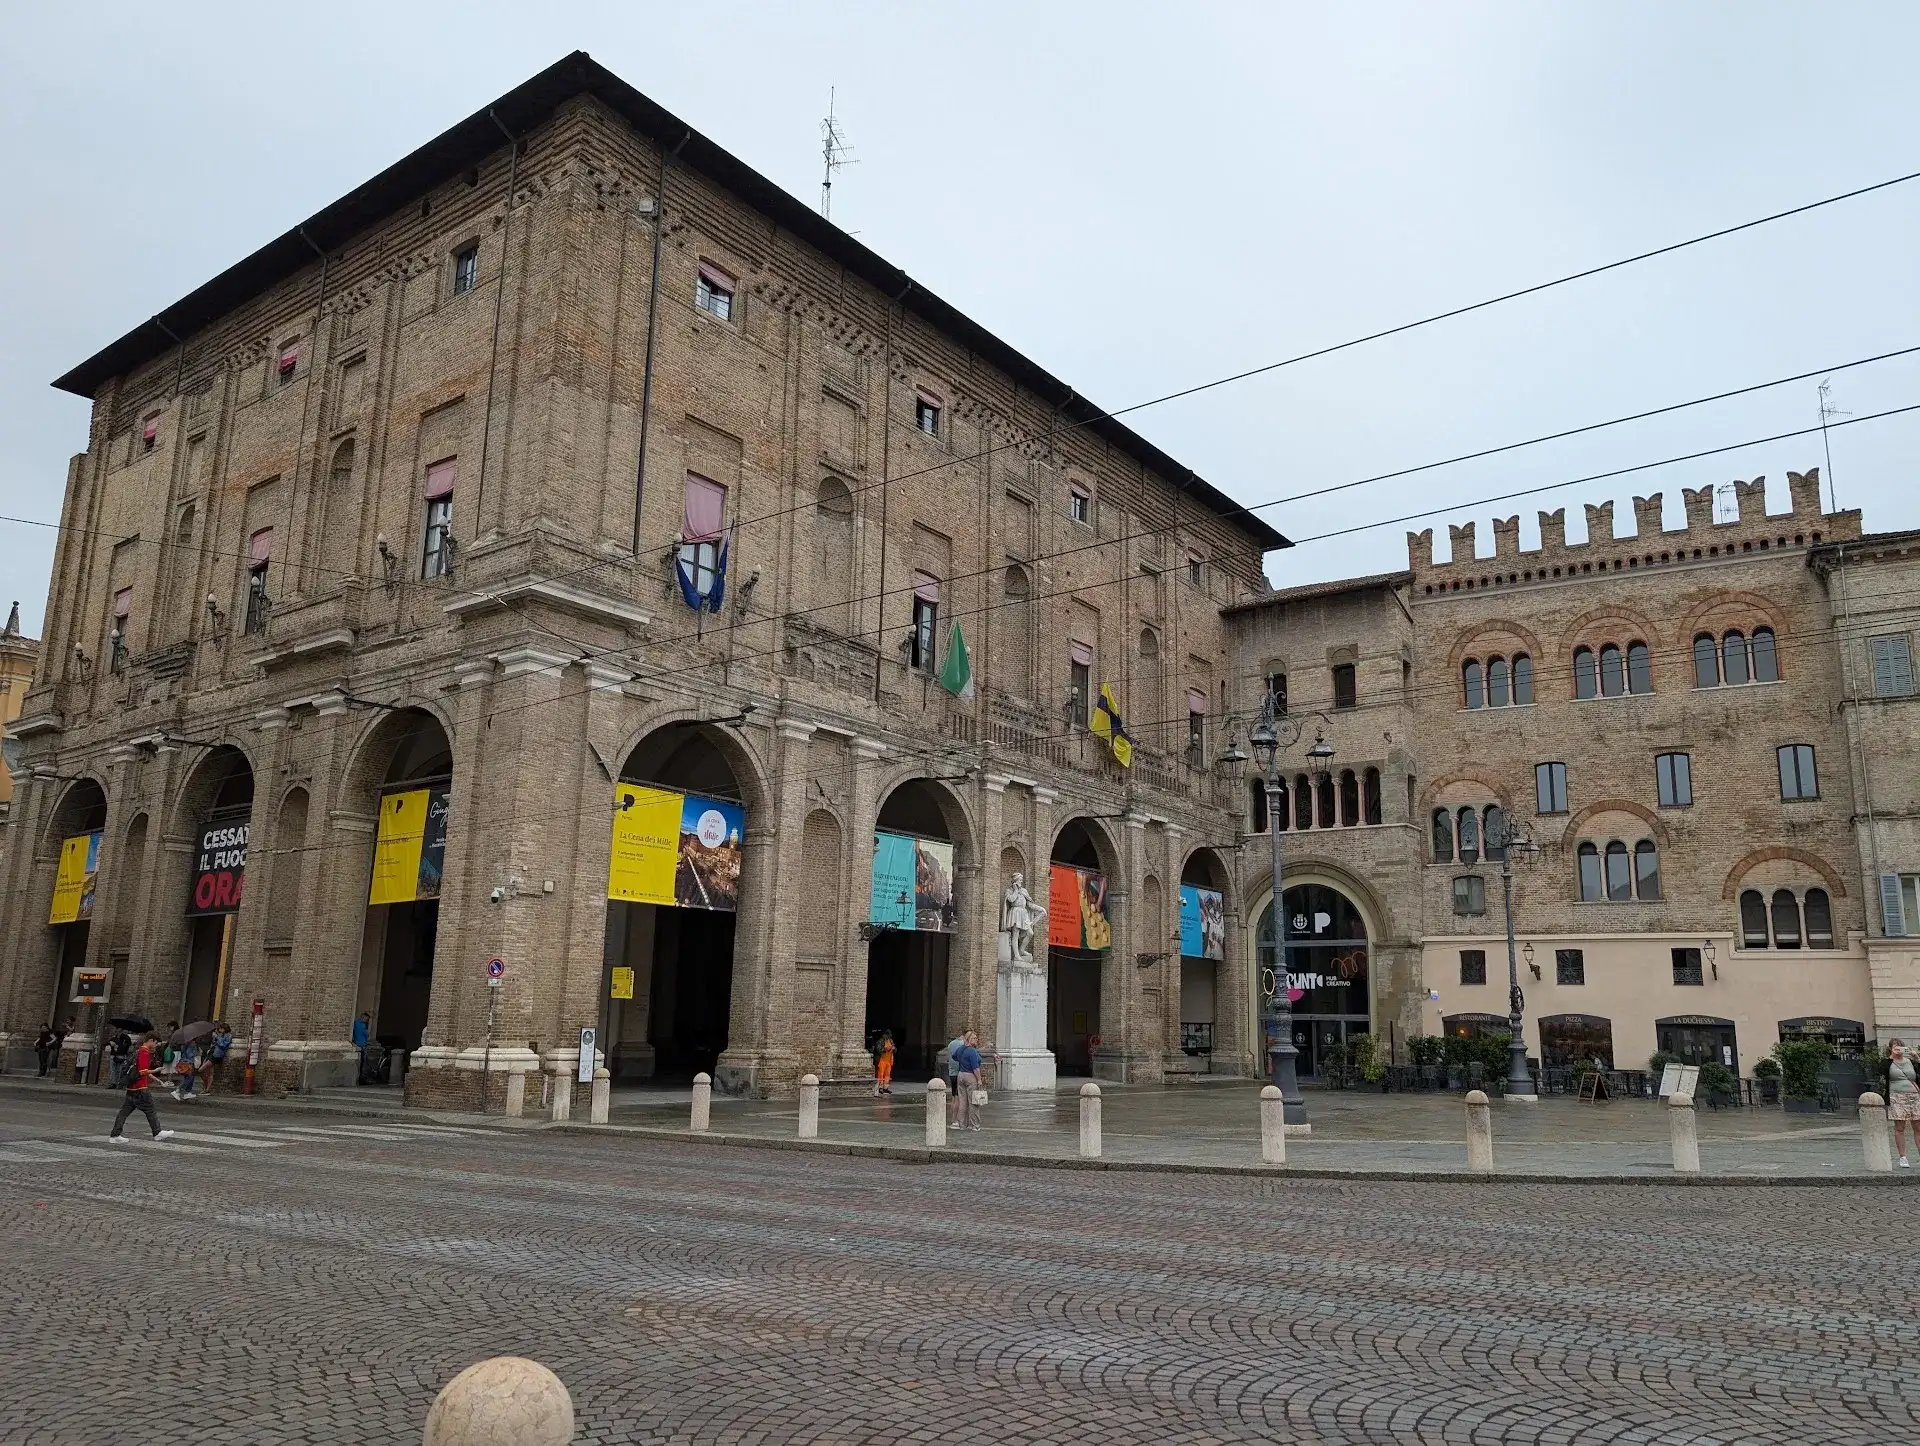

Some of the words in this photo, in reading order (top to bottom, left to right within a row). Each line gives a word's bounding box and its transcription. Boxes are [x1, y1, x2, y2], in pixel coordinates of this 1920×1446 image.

[619, 830, 627, 839] La
[627, 832, 644, 842] Cena
[644, 835, 656, 844] dei
[657, 836, 672, 846] Mille
[199, 853, 211, 871] IL
[1314, 912, 1331, 933] P
